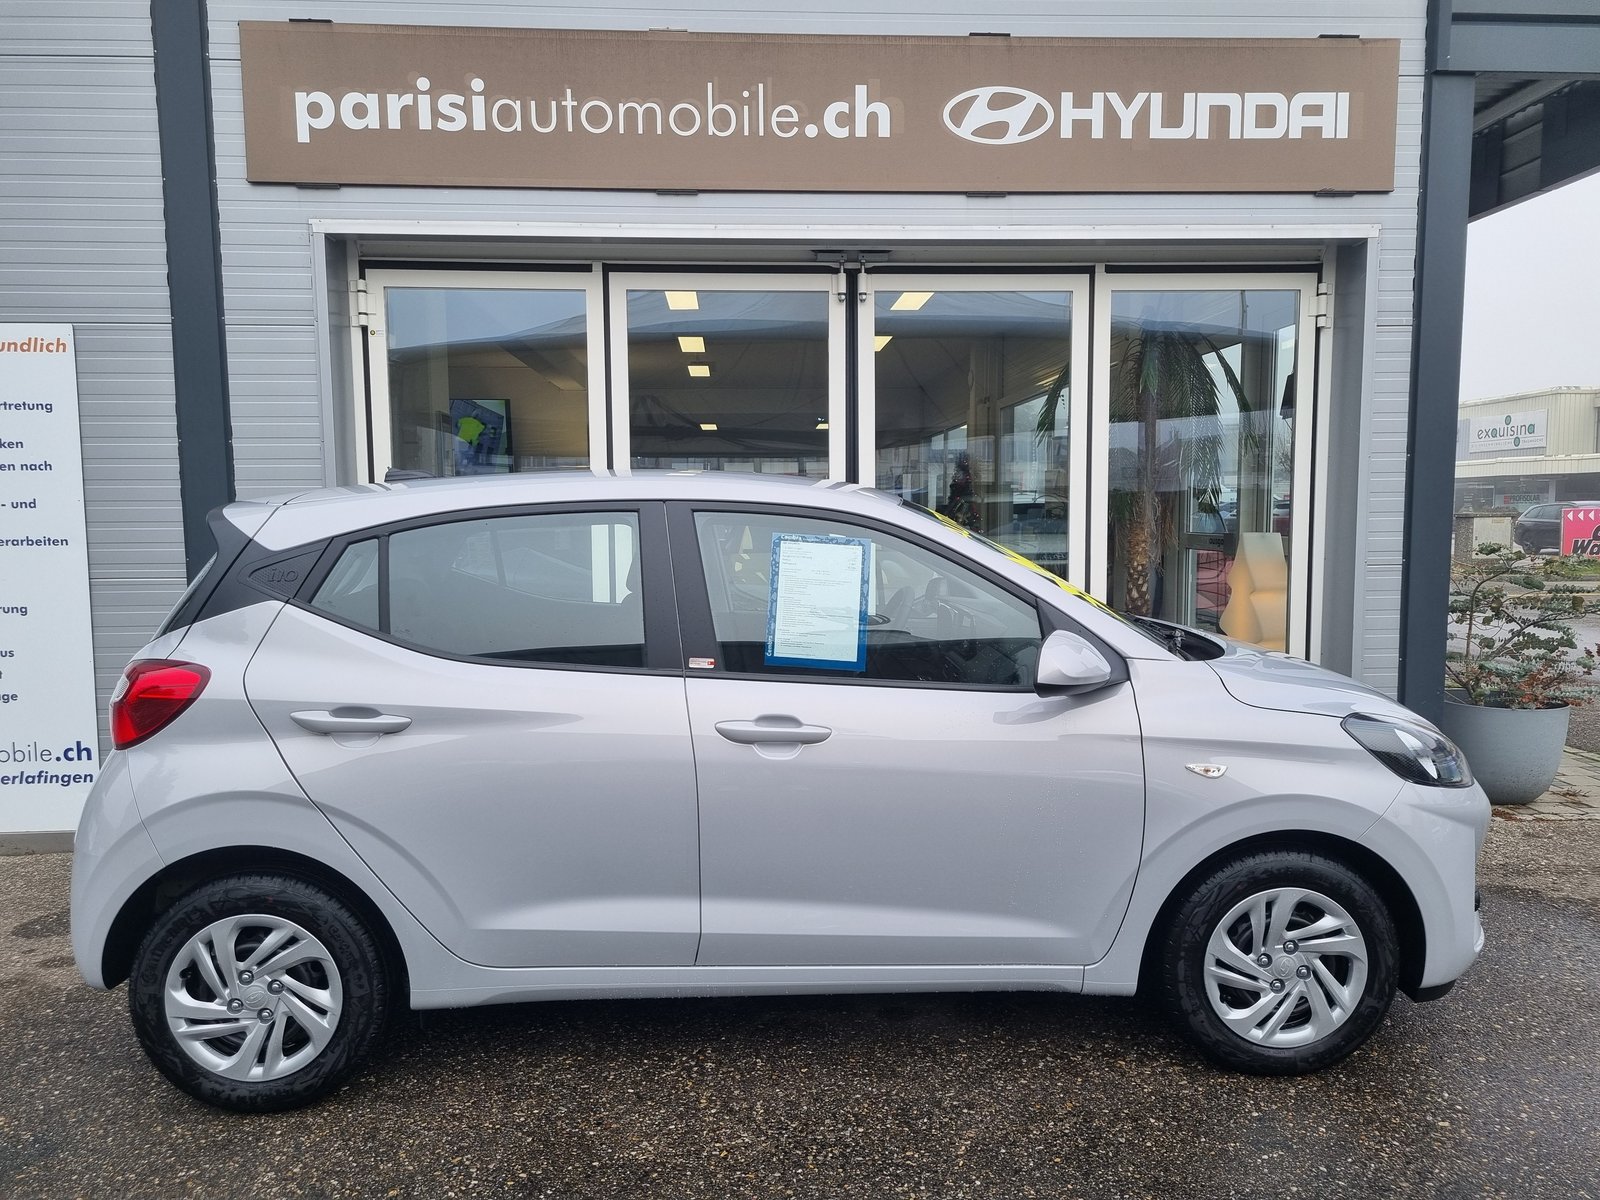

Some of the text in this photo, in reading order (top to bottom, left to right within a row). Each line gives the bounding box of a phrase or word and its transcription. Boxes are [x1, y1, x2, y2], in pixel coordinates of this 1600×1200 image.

[294, 77, 891, 143] parisiautomobile.ch
[1060, 91, 1350, 140] HYUNDAI
[20, 460, 53, 472] nach
[11, 498, 37, 509] und
[0, 770, 94, 787] erlafingen
